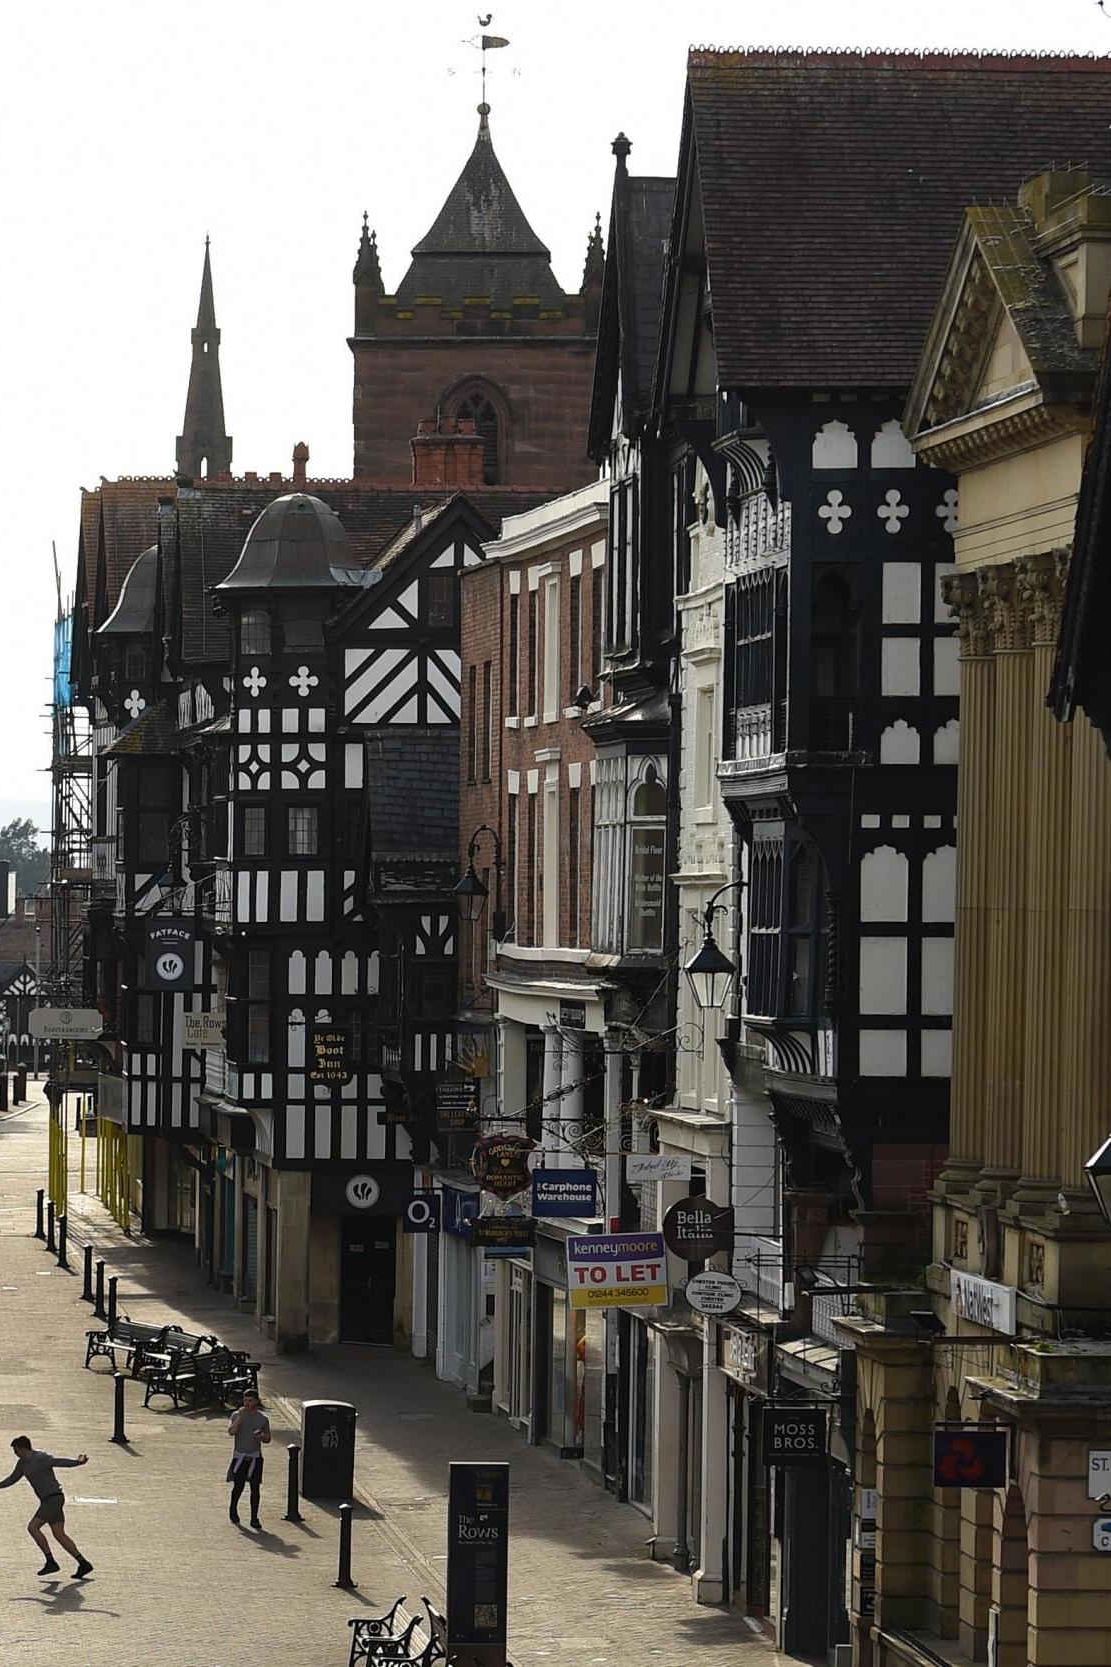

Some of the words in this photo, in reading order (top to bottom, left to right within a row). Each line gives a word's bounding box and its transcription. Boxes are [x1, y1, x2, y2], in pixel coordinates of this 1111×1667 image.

[150, 928, 191, 940] FATFACE
[185, 1015, 200, 1028] The
[326, 1034, 345, 1042] Olde
[315, 1044, 344, 1056] Boot
[317, 1058, 341, 1068] Inn
[541, 1182, 593, 1192] Carphone
[537, 1193, 593, 1201] Warehouse
[677, 1210, 712, 1224] Bella
[677, 1225, 713, 1240] Italia
[574, 1241, 657, 1257] kenneymoore
[574, 1266, 607, 1284] TO
[616, 1264, 661, 1282] LET
[588, 1290, 613, 1298] 01244
[774, 1424, 815, 1435] MOSS
[774, 1437, 819, 1449] BROS.
[457, 1514, 475, 1524] The
[458, 1524, 499, 1540] Rows
